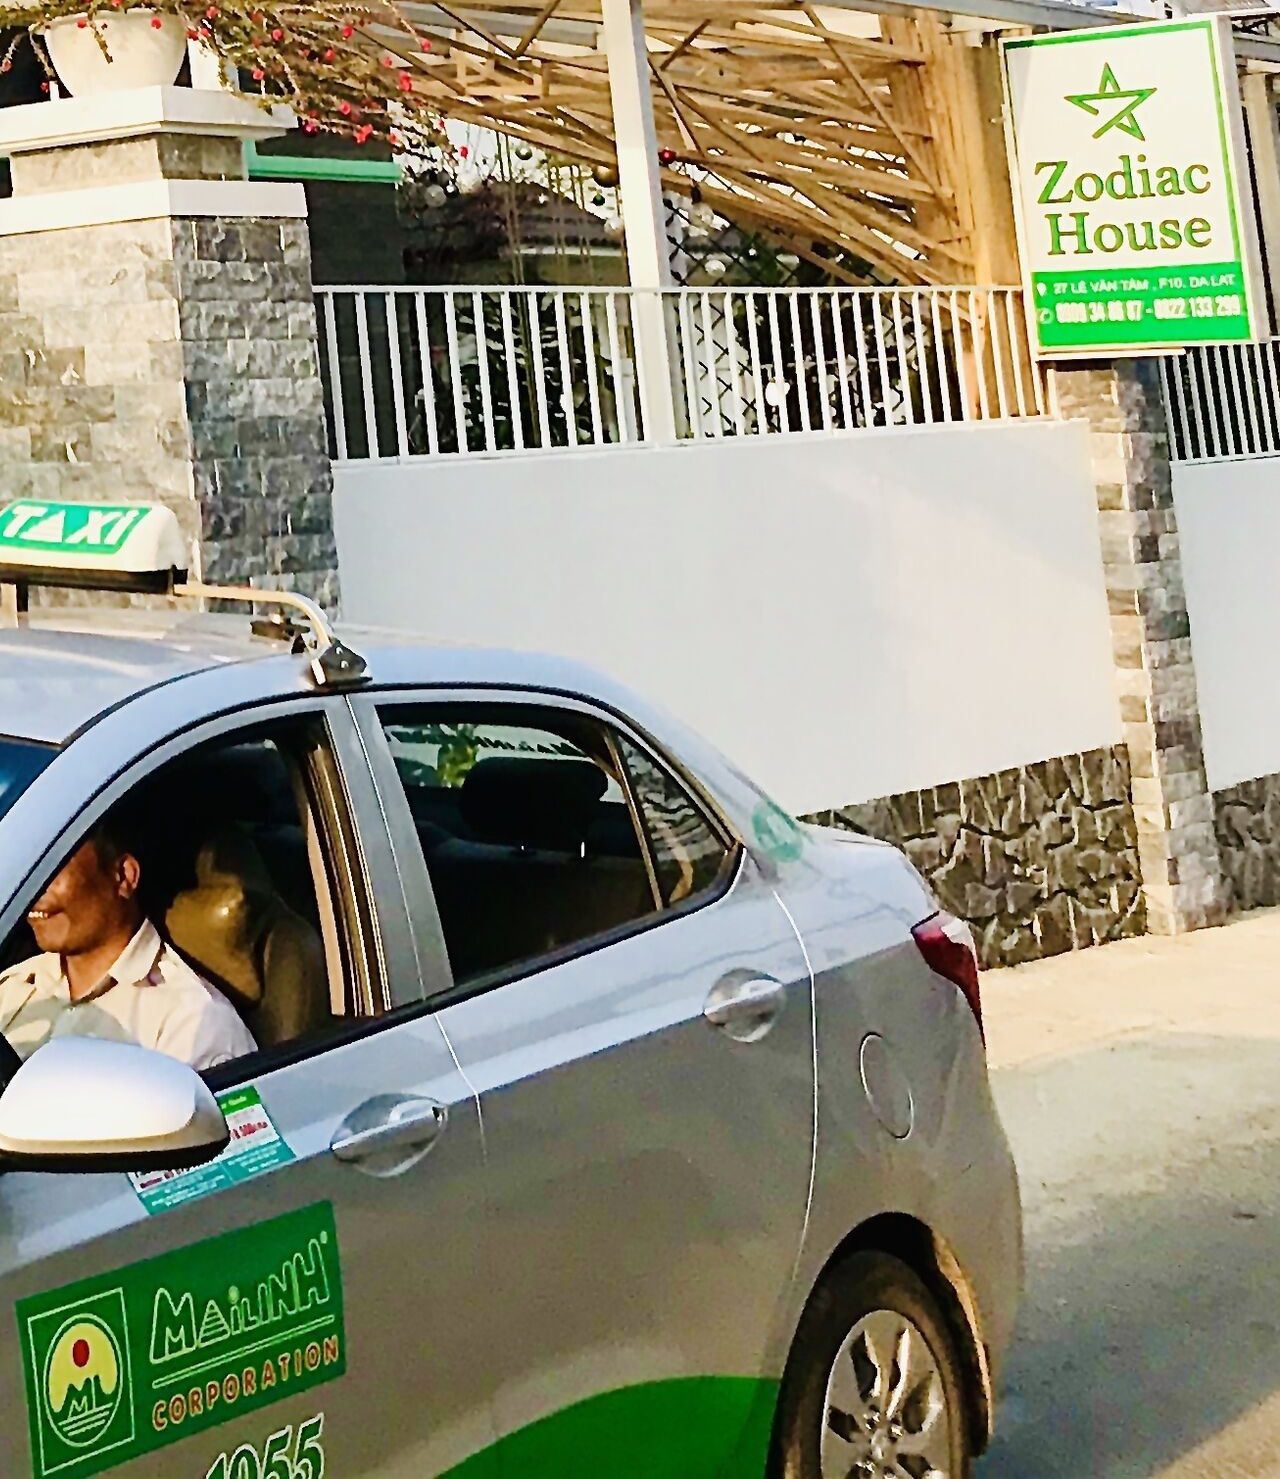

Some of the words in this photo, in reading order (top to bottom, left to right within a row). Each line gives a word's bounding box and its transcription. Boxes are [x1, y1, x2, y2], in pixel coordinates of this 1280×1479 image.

[1034, 153, 1211, 205] Zodiac
[1044, 211, 1212, 256] House
[151, 1335, 339, 1431] CORPORATION
